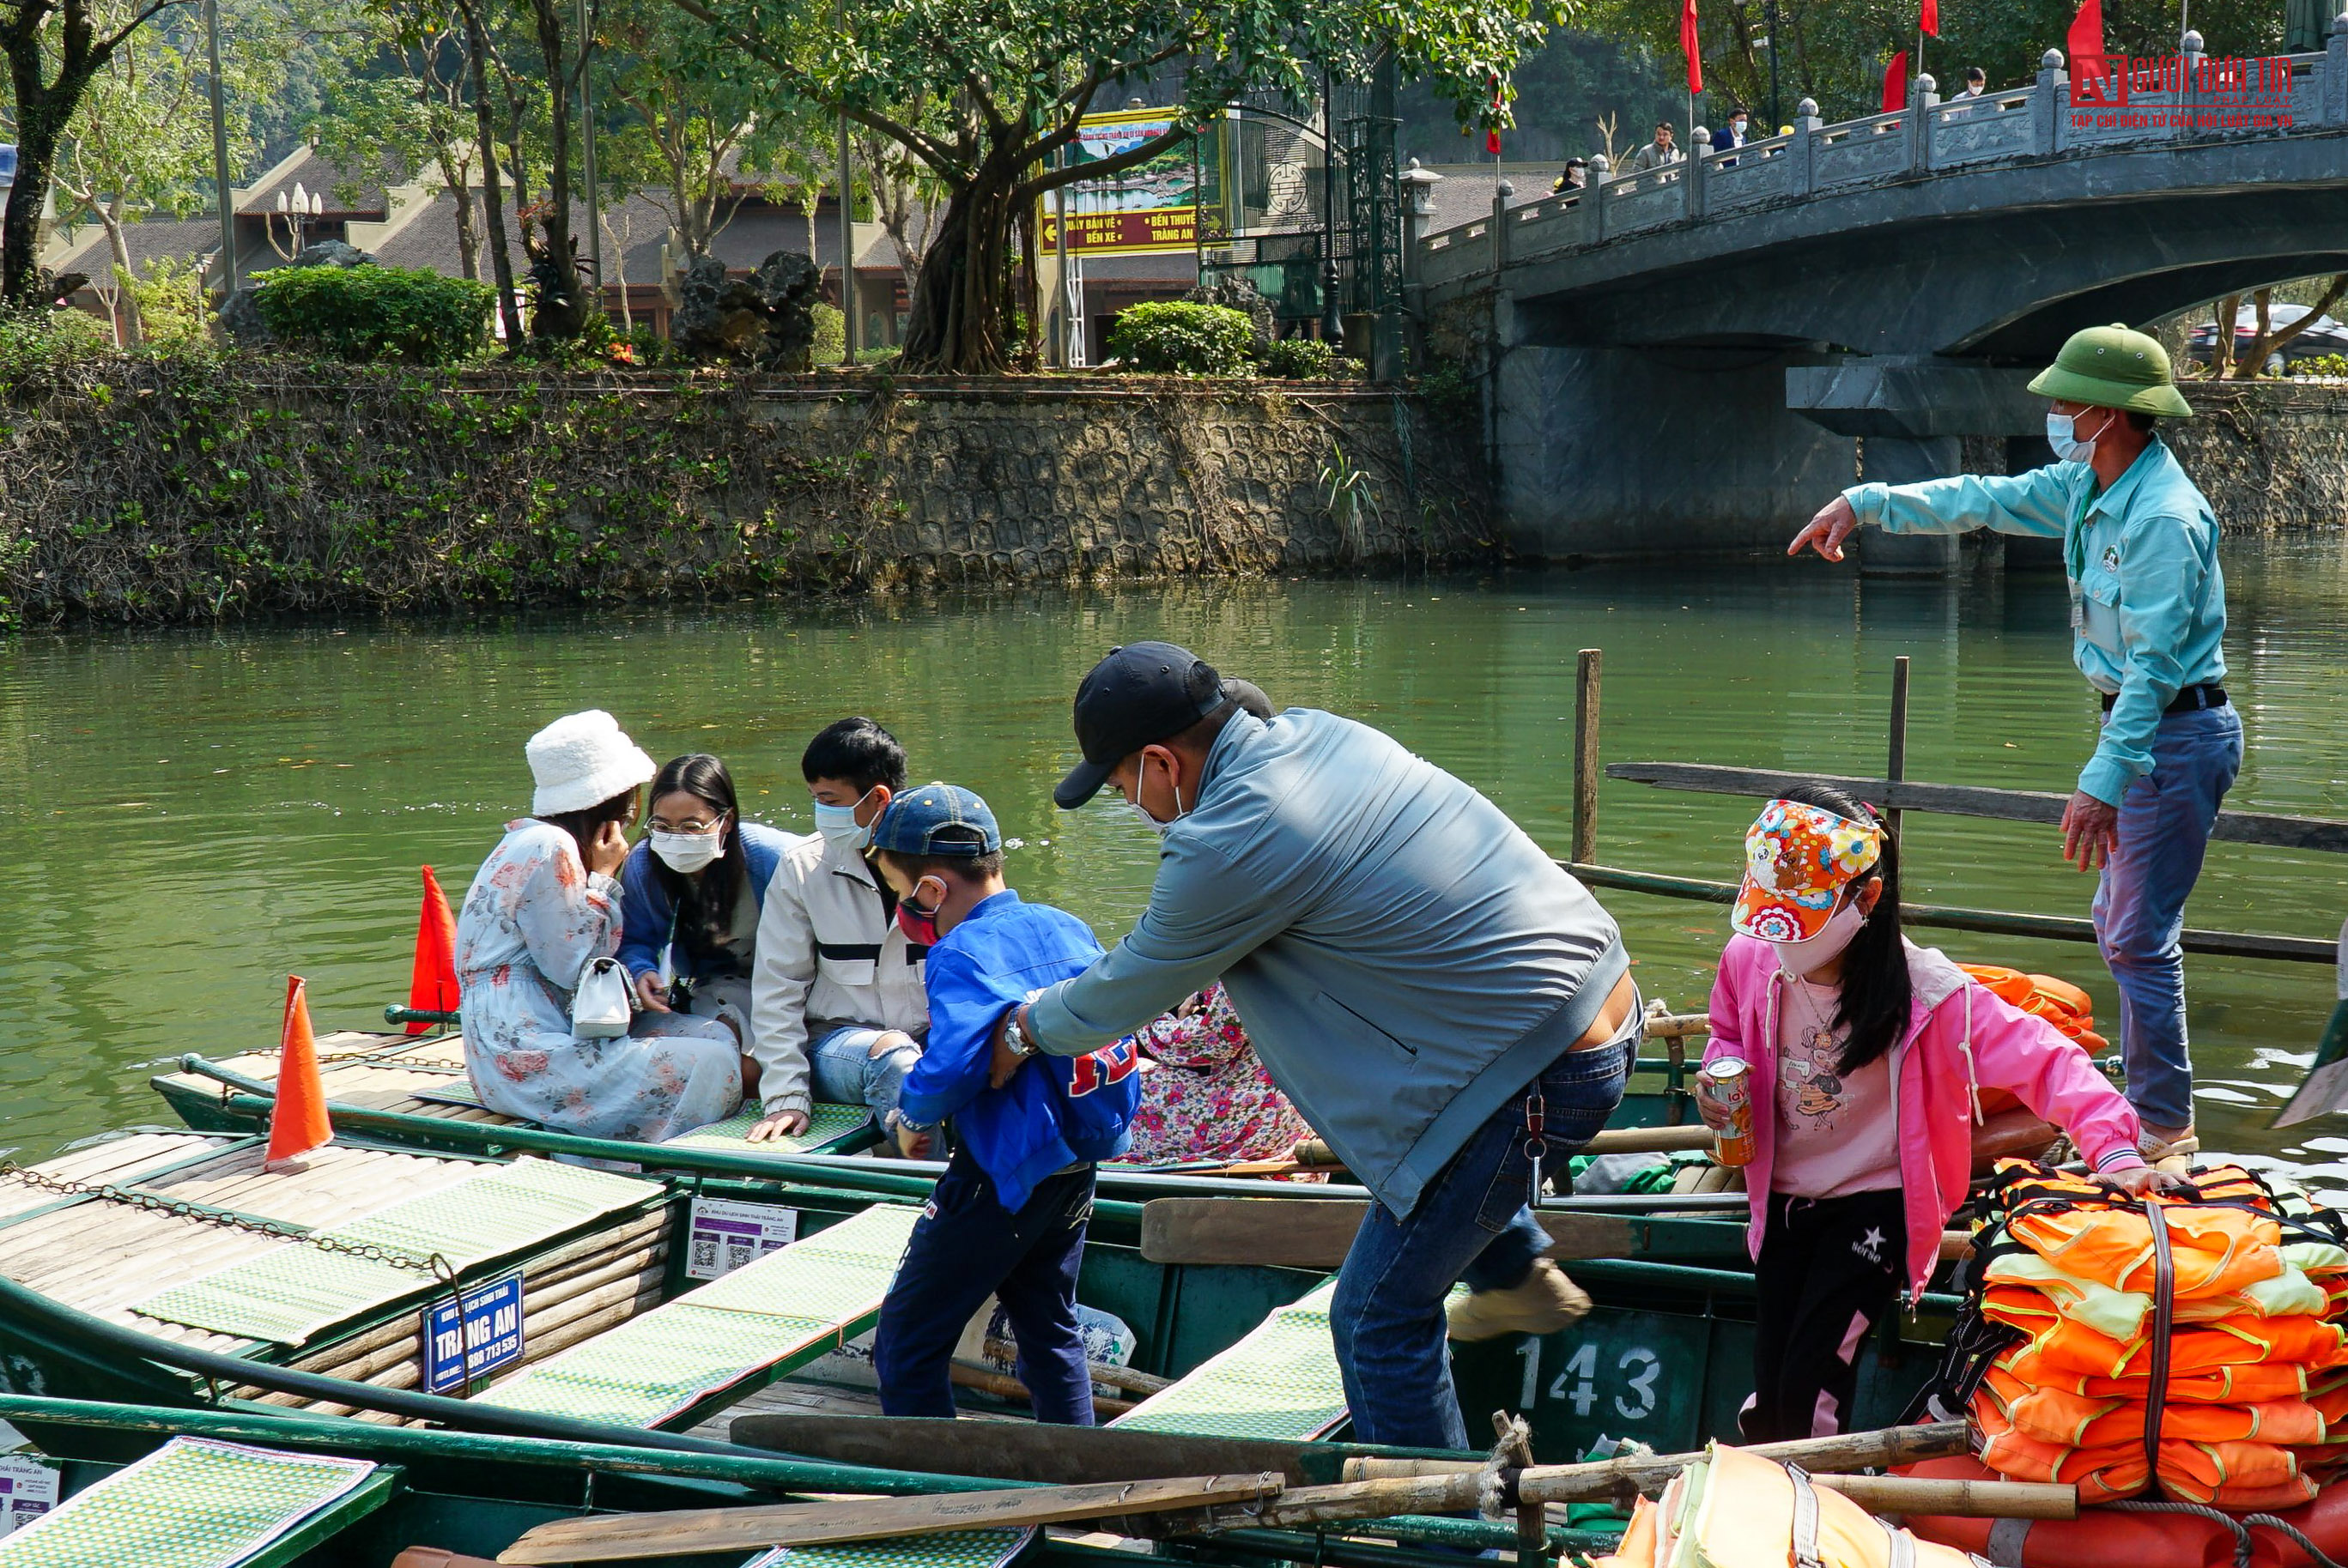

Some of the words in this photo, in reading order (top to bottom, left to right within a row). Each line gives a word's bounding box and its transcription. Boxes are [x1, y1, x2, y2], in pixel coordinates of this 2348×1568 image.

[1151, 213, 1168, 227] BẾN
[1086, 229, 1103, 243] BẾN
[1105, 232, 1116, 242] XE
[1152, 228, 1179, 241] TRÀNG
[1181, 228, 1193, 240] AN
[494, 1303, 516, 1338] AN
[485, 1341, 501, 1361] 713
[1516, 1336, 1660, 1420] 143
